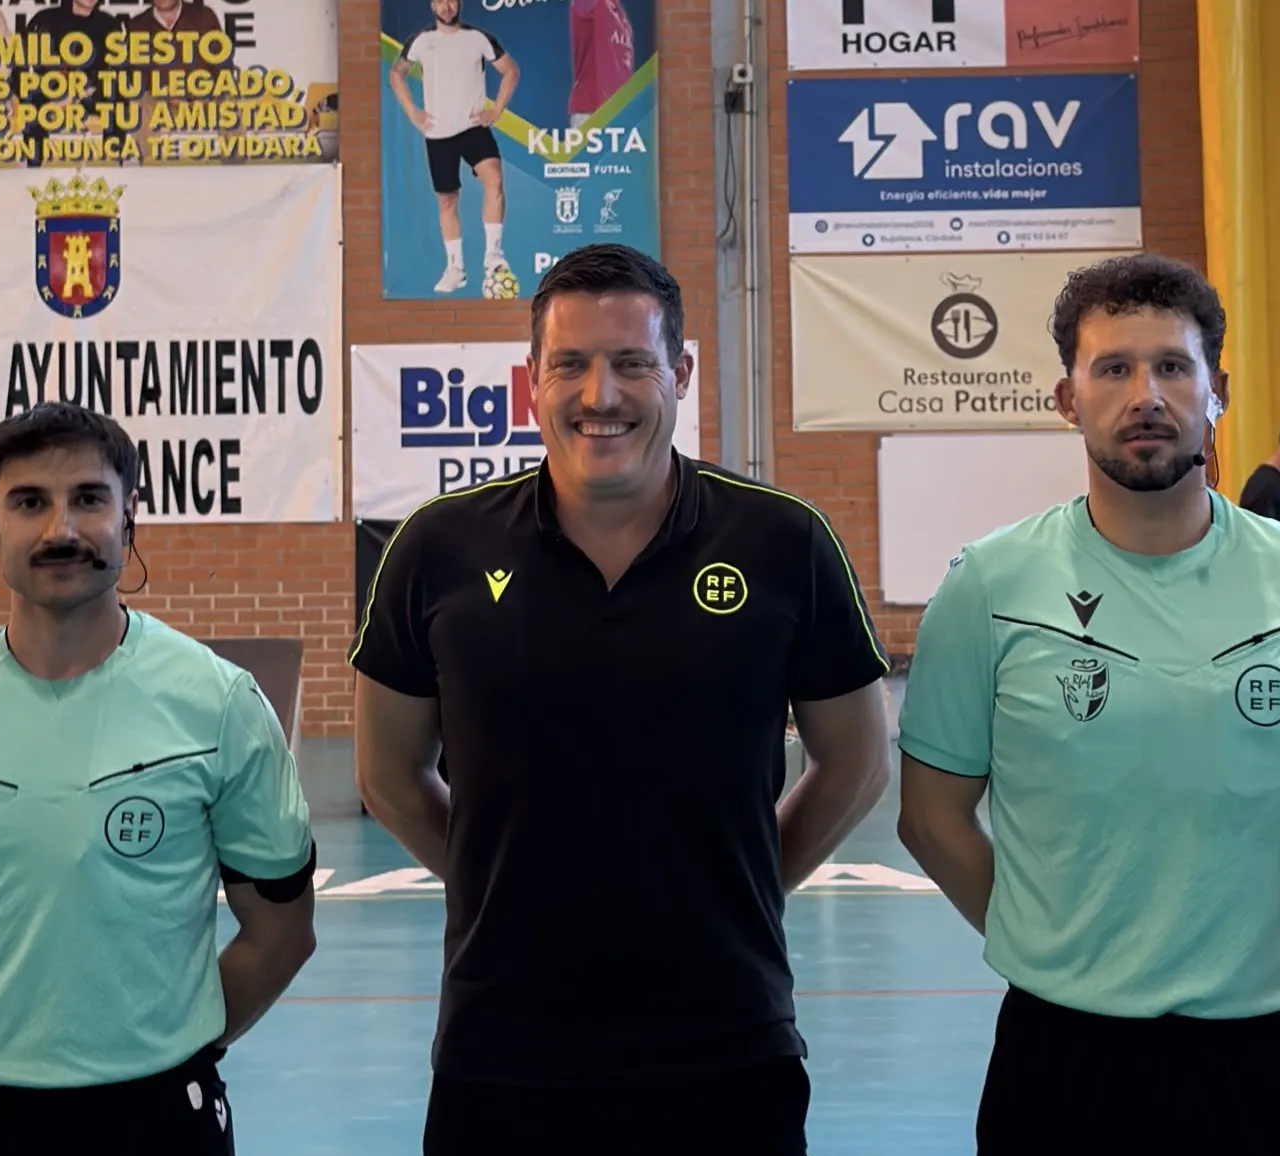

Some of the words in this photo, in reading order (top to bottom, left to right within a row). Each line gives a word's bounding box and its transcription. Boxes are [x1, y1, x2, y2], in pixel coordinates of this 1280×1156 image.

[104, 30, 234, 66] SESTO
[842, 31, 957, 54] HOGAR
[20, 70, 90, 99] POR
[98, 69, 143, 99] TU
[151, 68, 305, 101] LEGADO,
[18, 103, 87, 131] POR
[95, 102, 141, 131] TU
[148, 101, 307, 130] AMISTAD
[943, 100, 1081, 151] rav
[42, 136, 142, 162] NUNCA
[148, 136, 181, 159] TE
[527, 127, 648, 155] KIPSTA
[594, 165, 632, 175] FUTSAL
[945, 158, 1083, 179] instalaciones
[982, 189, 1009, 200] vida
[1011, 188, 1048, 202] mejor
[5, 337, 325, 417] AYUNTAMIENTO
[903, 367, 1033, 386] Restaurante
[878, 390, 944, 414] Casa
[955, 389, 1057, 413] Patricio
[134, 438, 243, 516] ANCE
[707, 575, 736, 588] RF
[707, 589, 736, 602] EF
[1250, 679, 1280, 693] RF
[1250, 698, 1280, 711] EF
[121, 812, 154, 826] RF
[119, 829, 152, 843] EF
